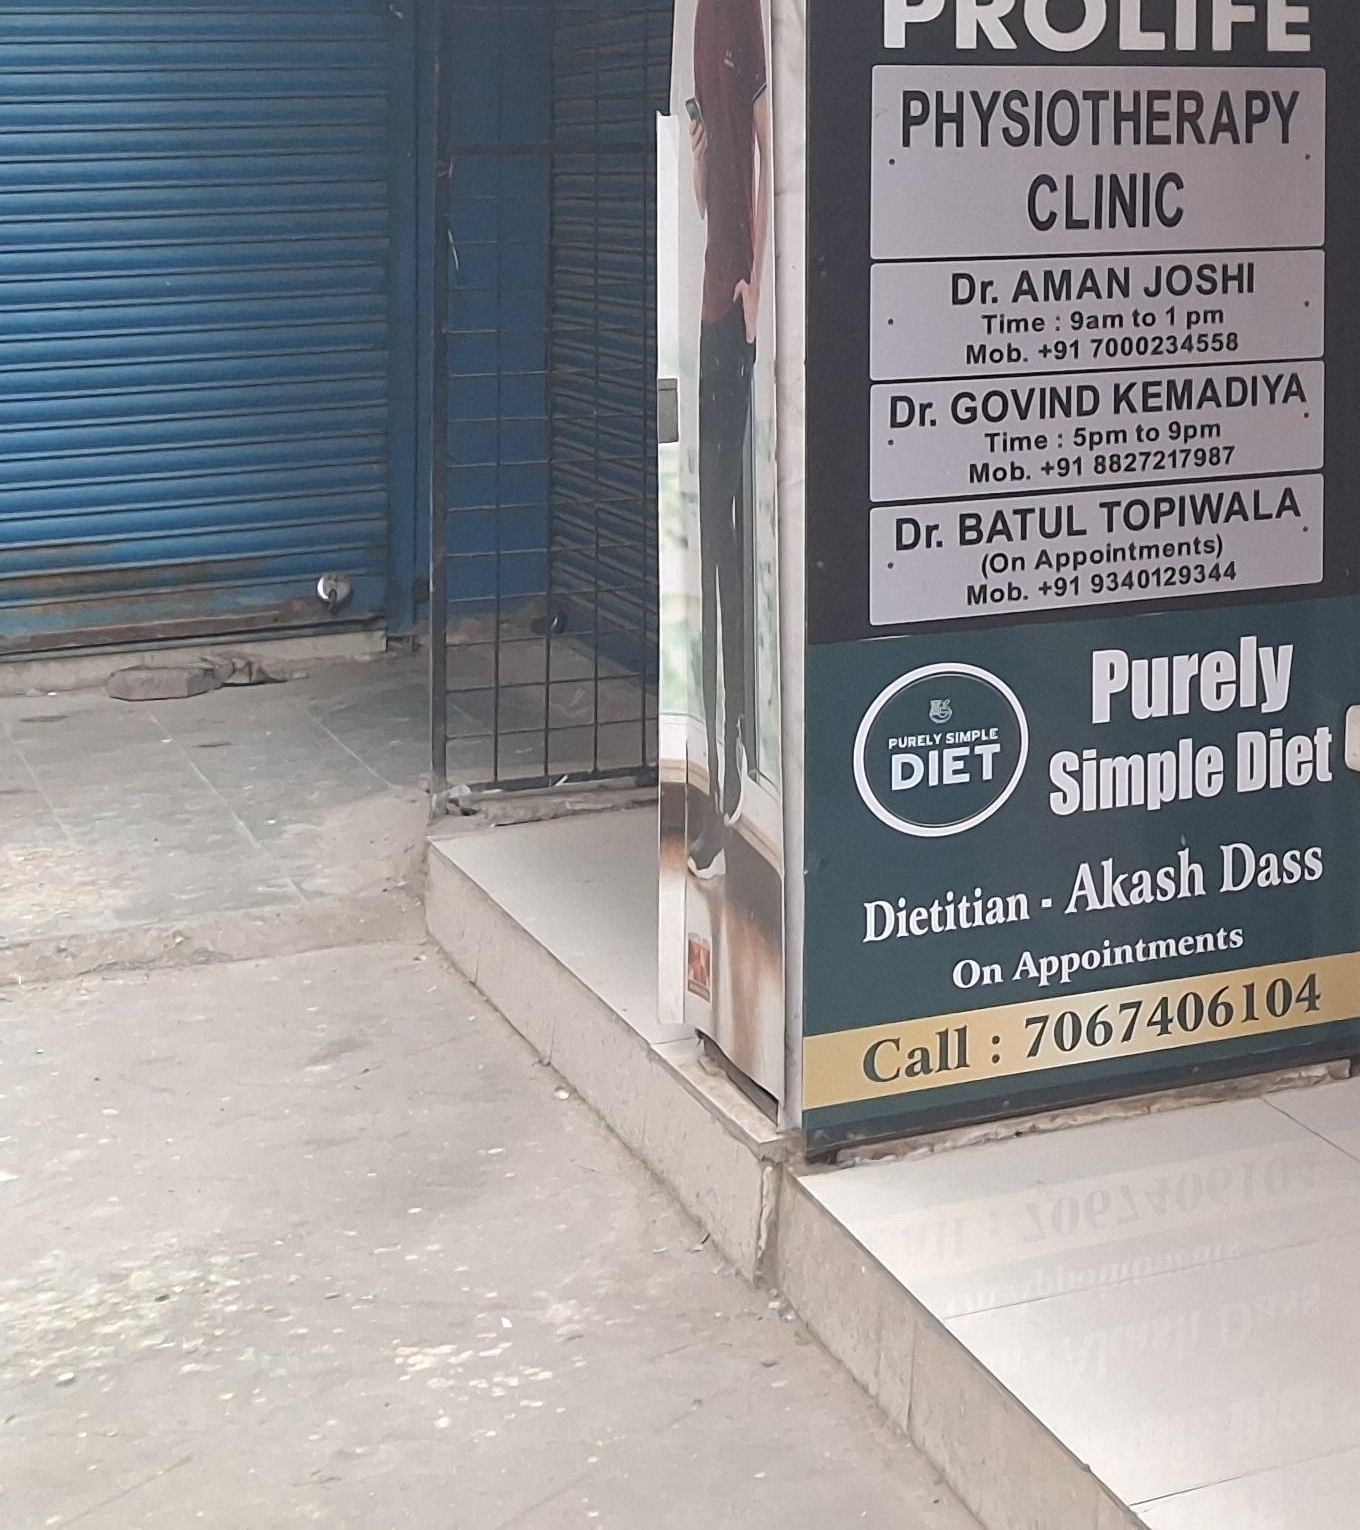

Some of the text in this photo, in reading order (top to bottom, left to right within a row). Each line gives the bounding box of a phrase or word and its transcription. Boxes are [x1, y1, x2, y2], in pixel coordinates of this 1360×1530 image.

[901, 88, 1300, 148] PHYSIOTHERAPY
[1026, 171, 1185, 231] CLINIC
[951, 262, 1255, 306] Dr. AMAN JOSHI
[981, 312, 1046, 335] Time
[1069, 310, 1124, 331] 9am
[1133, 308, 1157, 328] to
[1166, 307, 1177, 327] 1
[1187, 309, 1224, 331] pm
[966, 332, 1239, 365] Mob. +91 7000234558
[889, 372, 1308, 429] Dr. GOVIND KEMADIYA
[985, 430, 1047, 453] Time
[1073, 426, 1128, 451] 5pm
[1135, 423, 1159, 445] to
[1168, 420, 1222, 445] 9pm
[969, 446, 1236, 485] Mob. +91 8827217987
[895, 487, 1302, 552] Dr. BATUL TOPIWALA
[980, 535, 1224, 577] (On Appointments)
[966, 561, 1238, 607] Mob. +91 9340129344
[1090, 635, 1295, 725] Purely
[887, 726, 999, 750] PURELY SIMPLE
[890, 742, 1001, 791] DIET
[1048, 725, 1334, 817] Simple Diet
[862, 885, 1030, 944] Dietitian
[1064, 845, 1206, 916] Akash
[1219, 840, 1324, 894] Dass
[951, 925, 1245, 990] On Appointments
[862, 1023, 971, 1084] Call
[1023, 973, 1322, 1060] 7067406104
